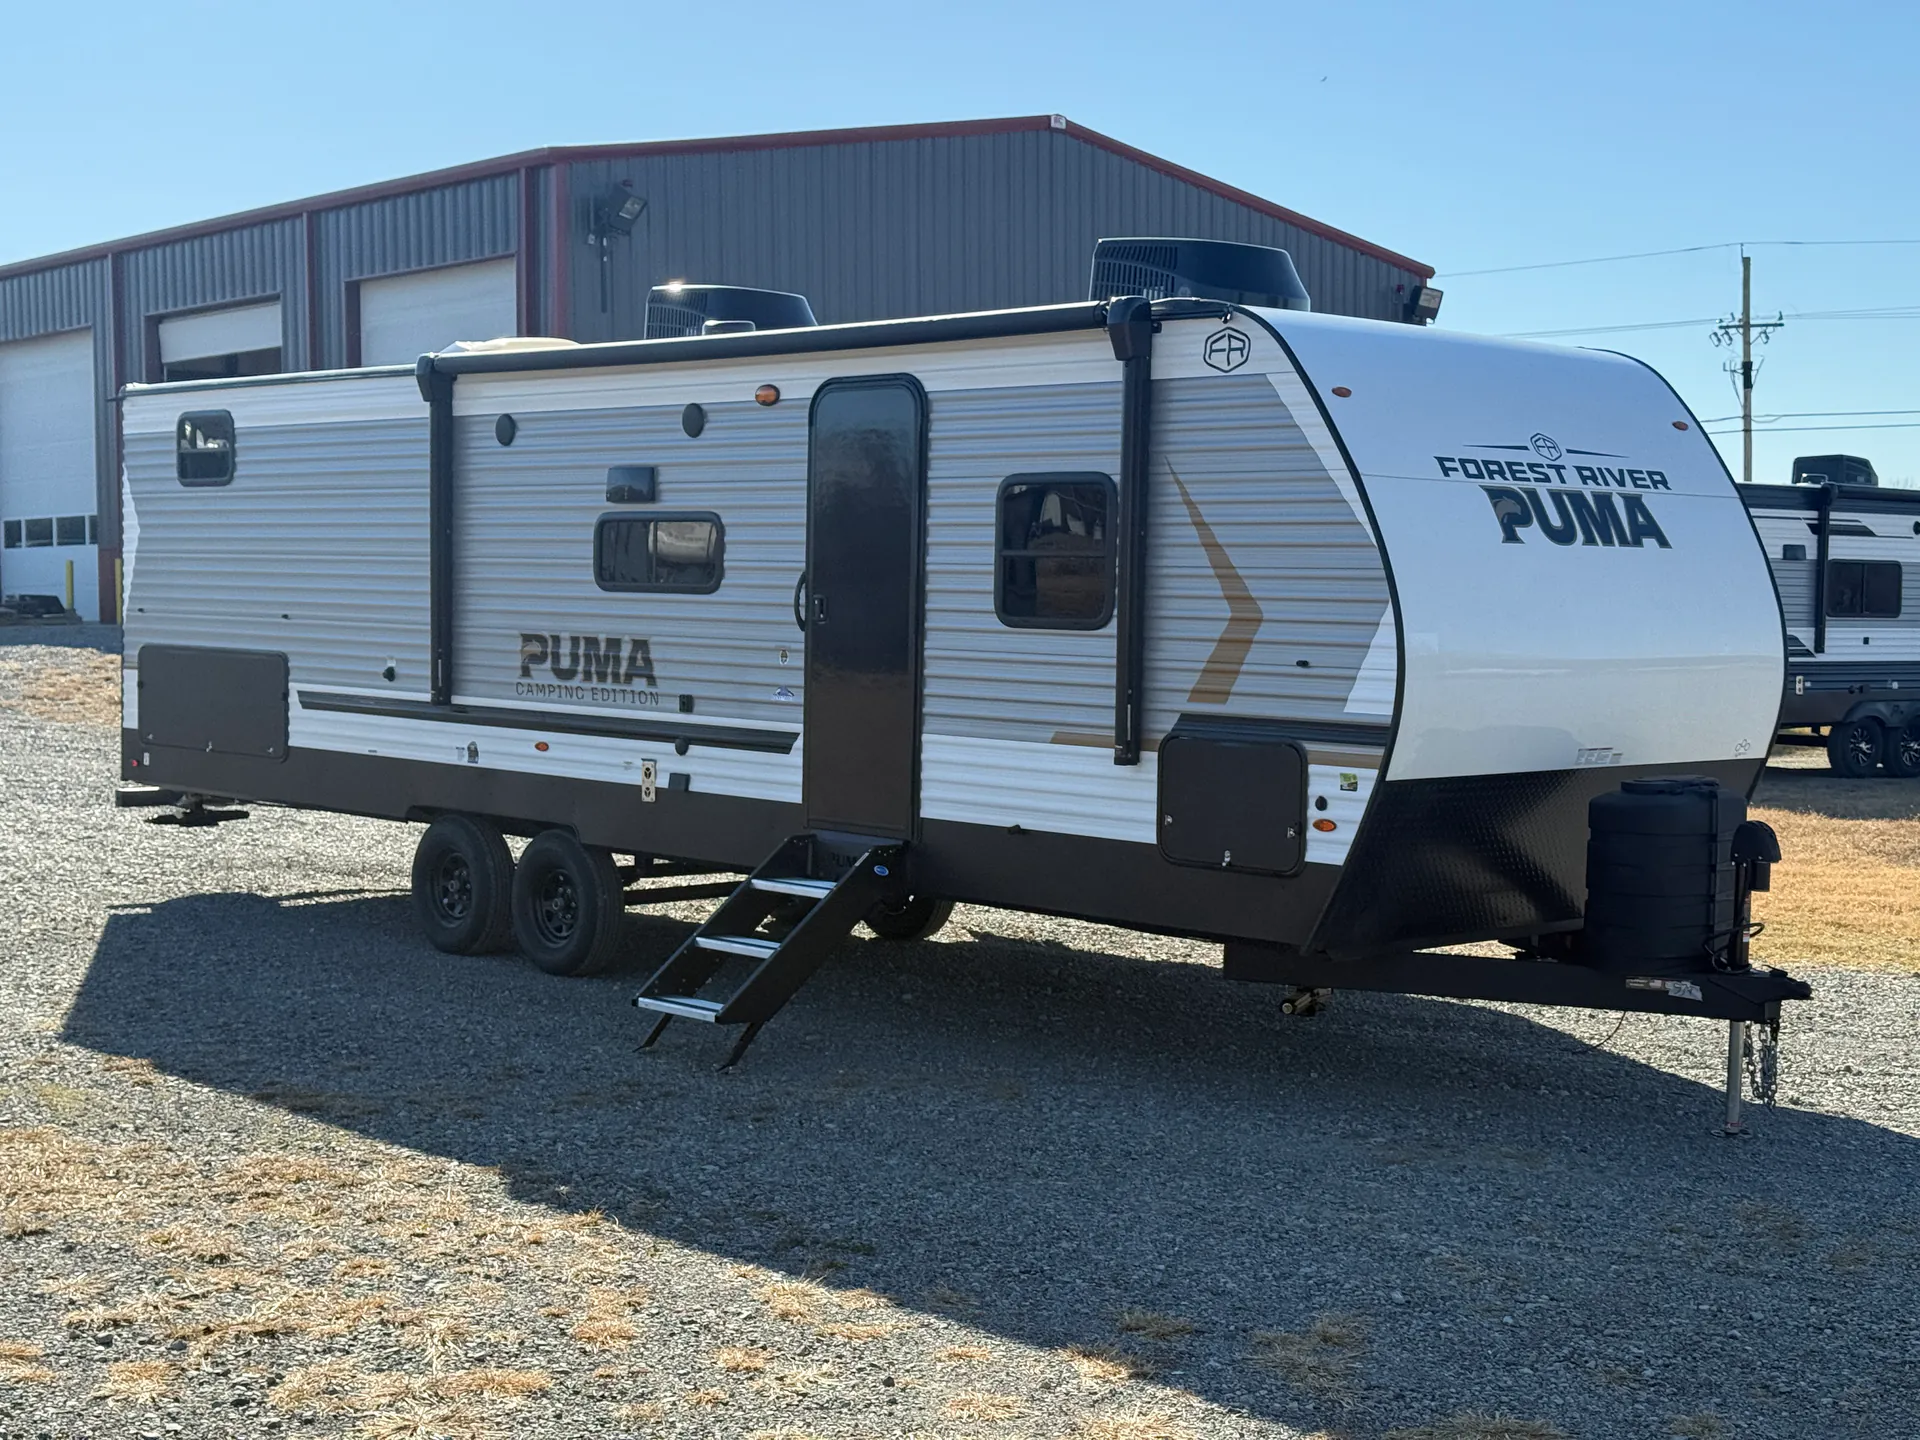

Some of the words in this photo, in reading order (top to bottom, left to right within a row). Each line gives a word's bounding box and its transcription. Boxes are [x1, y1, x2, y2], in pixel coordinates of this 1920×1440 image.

[1433, 456, 1567, 484] FOREST
[1572, 465, 1672, 490] RIVER
[1478, 485, 1673, 549] PUMA
[520, 633, 658, 687] PUMA
[515, 682, 585, 700] CAMPING
[591, 687, 660, 706] EDITION
